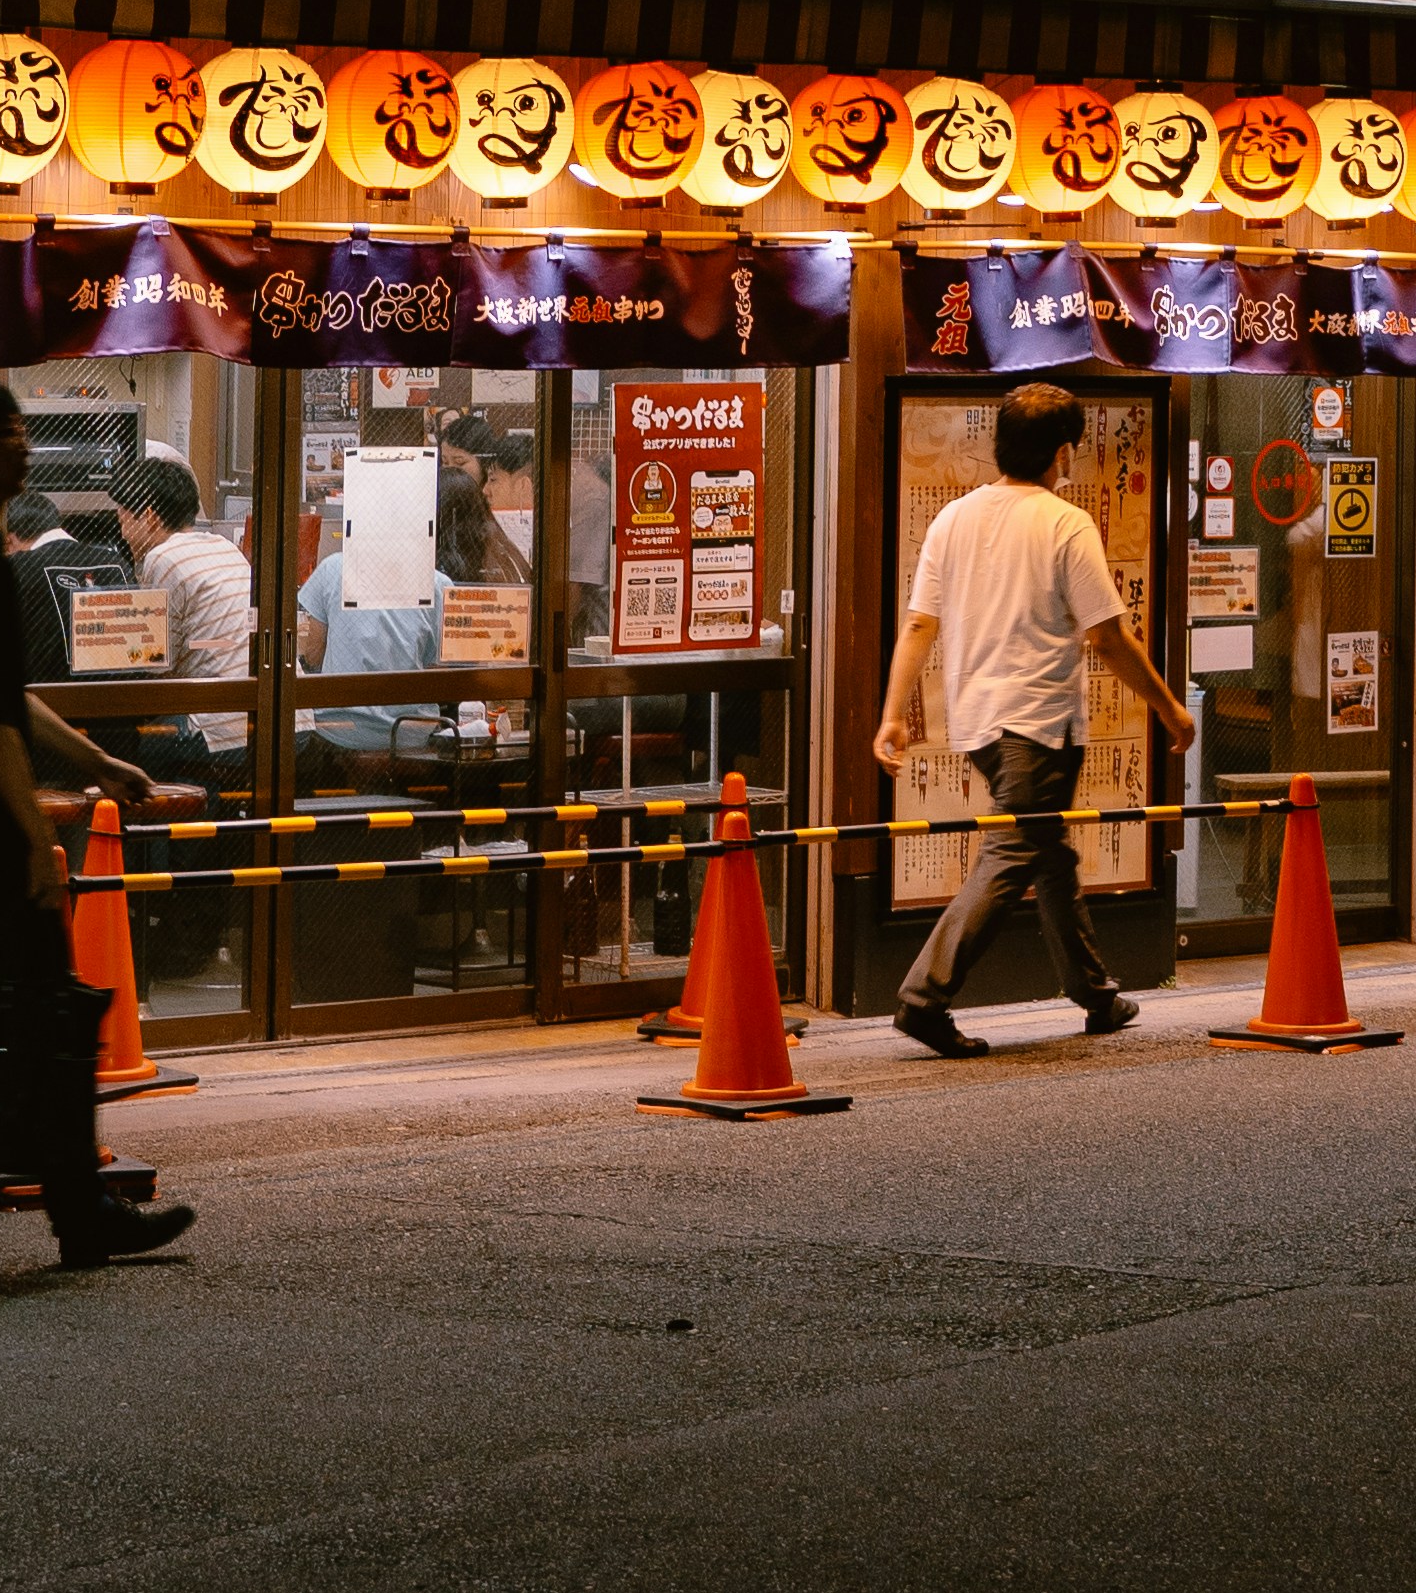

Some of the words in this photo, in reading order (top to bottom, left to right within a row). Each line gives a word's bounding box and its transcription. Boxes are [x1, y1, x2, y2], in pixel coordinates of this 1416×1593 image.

[68, 273, 229, 318] 創業昭和四年
[260, 268, 451, 341] 串かつだるま
[476, 294, 665, 327] 大阪新世界元祖串かつ
[1153, 285, 1299, 347] 串かつだるま
[931, 281, 973, 357] 元祖
[406, 367, 434, 379] AED
[632, 394, 744, 436] 串かつだるま
[643, 436, 737, 451] 公式アプリができました!
